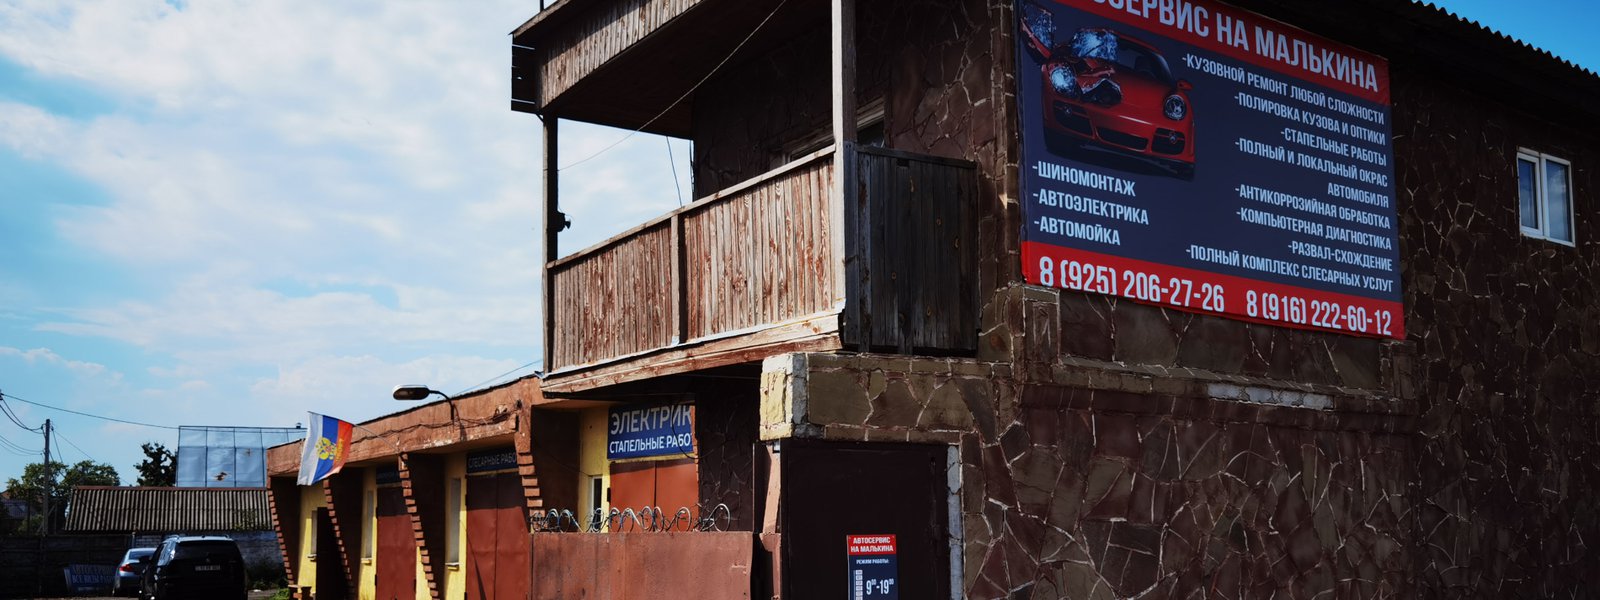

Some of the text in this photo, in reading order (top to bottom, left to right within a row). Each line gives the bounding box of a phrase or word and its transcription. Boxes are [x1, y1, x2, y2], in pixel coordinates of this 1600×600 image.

[1216, 13, 1248, 51] НА
[1255, 26, 1379, 93] МАЛЬКИНА
[1182, 54, 1385, 126] -КУЗОВНОЙ РЕМОНТ ЛЮБОЙ СЛОЖНОСТИ
[1234, 92, 1386, 146] -ПОЛИРОВКА КУЗОВА И ОПТИКИ
[1234, 137, 1388, 187] -ПОЛНЫЙ И ЛОКАЛЬНЫЙ ОКРАС
[1280, 128, 1387, 166] -СТАПЕЛЬНЫЕ РАБОТЫ
[1032, 161, 1136, 197] -ШИНОМОНТАЖ
[1327, 183, 1389, 208] АВТОМОБИЛЯ
[1032, 188, 1149, 225] -АВТОЭЛЕКТРИКА
[1235, 184, 1391, 229] -АНТИКОРРОЗИЙНАЯ ОБРАБОТКА
[1034, 216, 1121, 246] -АВТОМОЙКА
[1236, 207, 1392, 251] -КОМПЬЮТЕРНАЯ ДИАГНОСТИКА
[1185, 245, 1393, 293] -ПОЛНЫЙ КОМПЛЕКС СЛЕСАРНЫХ УСЛУГ
[1287, 240, 1393, 272] -РАЗВАЛ-СХОЖДЕНИЕ
[1039, 256, 1391, 336] 8 (925) 206-27-26 8 (916) 222-60-12
[468, 454, 500, 468] СЛЕСАРНЫЕ
[609, 432, 692, 454] СТАПЕЛЬНЫЕ РАБО
